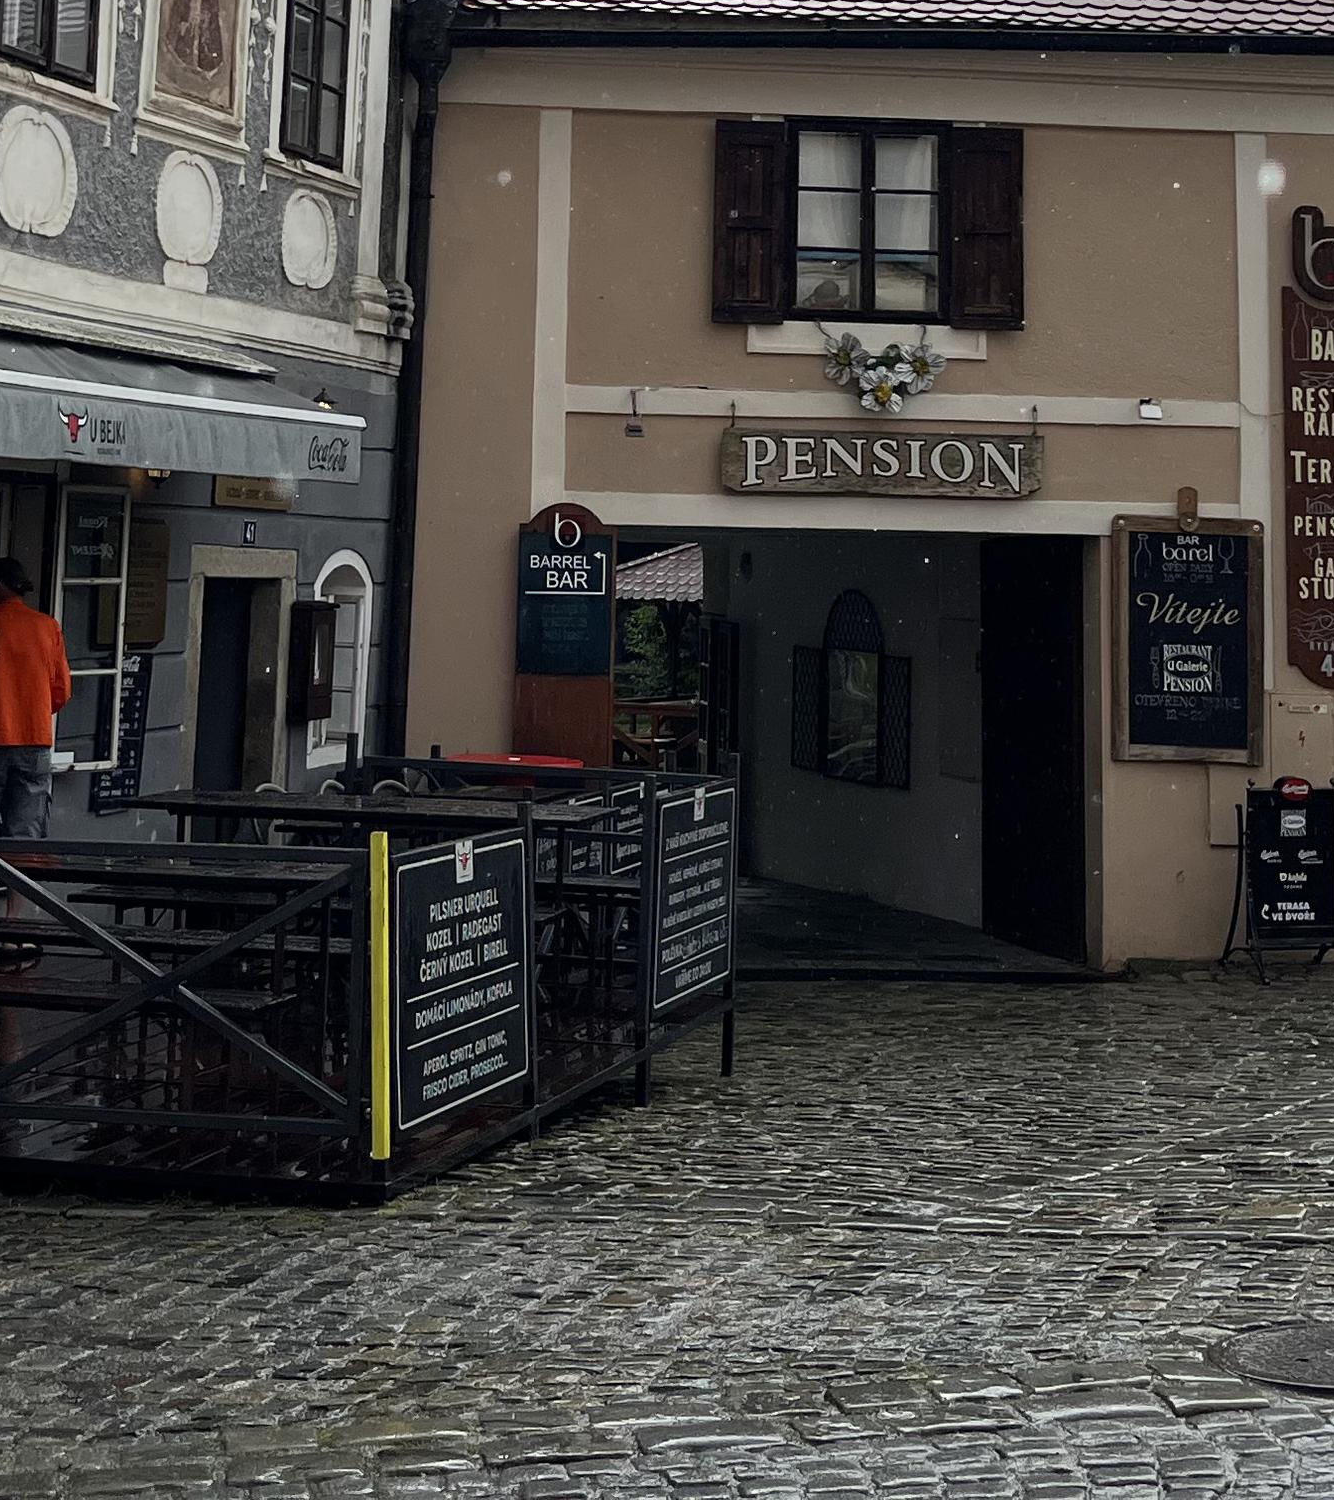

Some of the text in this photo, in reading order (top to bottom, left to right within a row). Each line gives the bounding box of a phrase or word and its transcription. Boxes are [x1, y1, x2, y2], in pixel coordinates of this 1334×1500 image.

[89, 418, 97, 442] U
[741, 436, 1025, 493] PENSION
[246, 522, 255, 543] 41
[1177, 535, 1200, 545] BAR
[530, 554, 591, 569] BARREL
[546, 571, 588, 589] BAR
[1136, 592, 1241, 635] Vítejte
[1163, 644, 1212, 660] RESTAURANT
[1176, 660, 1209, 672] Galerie
[1163, 673, 1213, 692] PENSION
[429, 887, 499, 923] PILSNER URQUELL
[1277, 902, 1310, 910] TERASA
[1272, 912, 1283, 921] VE
[426, 928, 453, 952] KOZEL
[462, 913, 503, 941] RADEGAST
[419, 951, 449, 983] ČERNÝ
[449, 949, 474, 973] KOZEL
[415, 998, 446, 1030] DOMÁCÍ
[486, 979, 513, 1002] KOFOLA
[423, 1052, 450, 1077] APEROL
